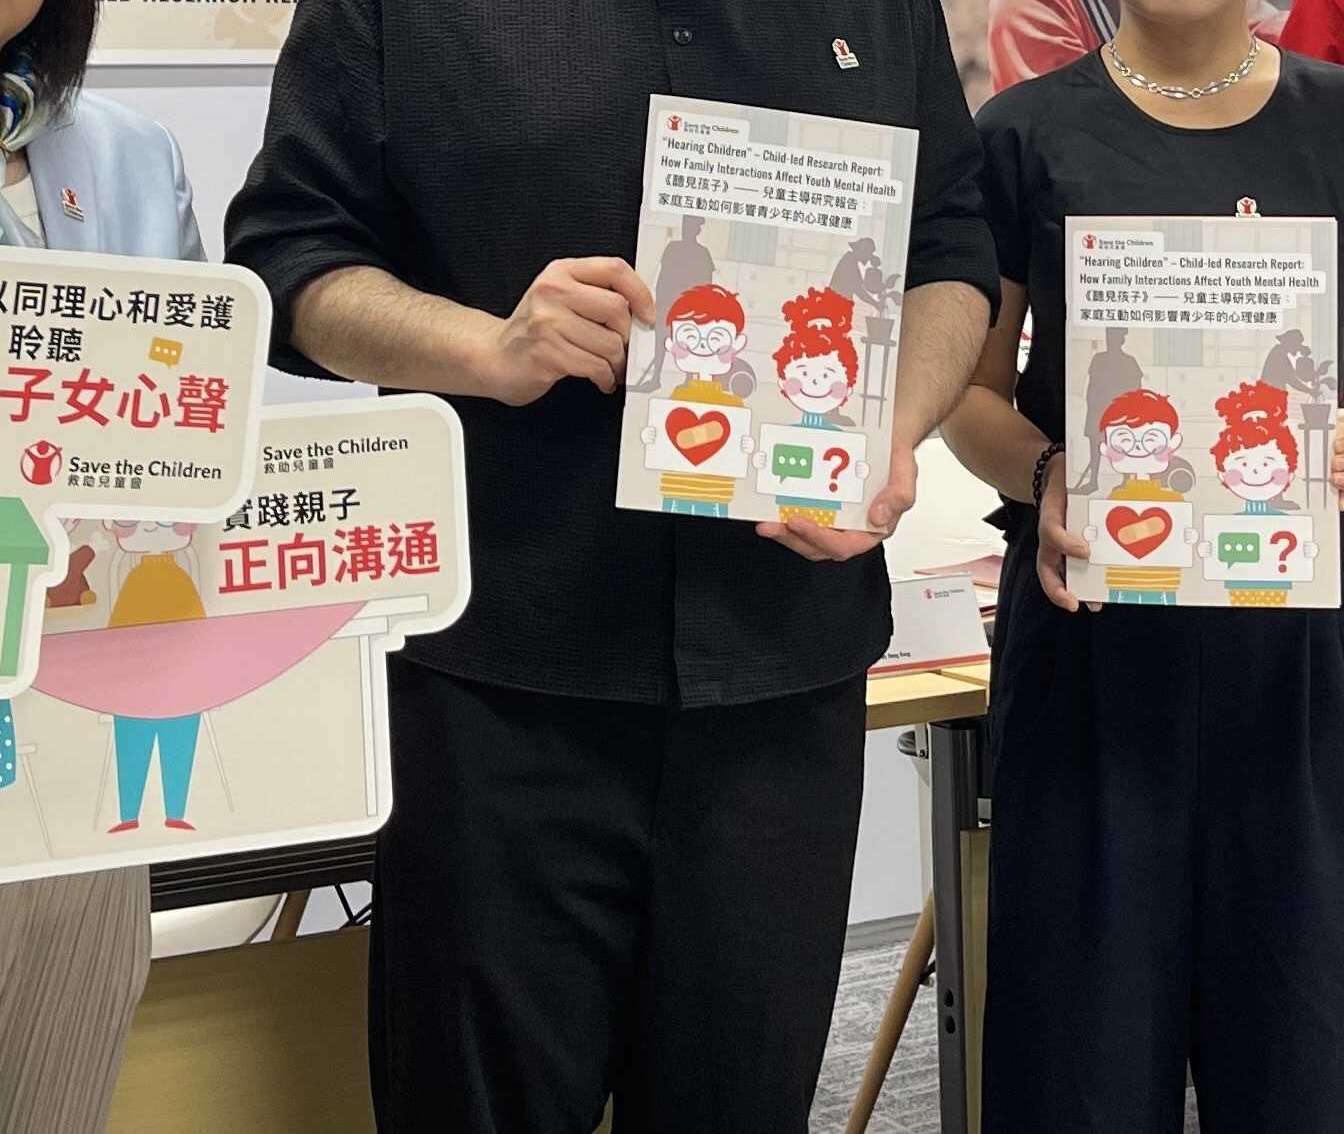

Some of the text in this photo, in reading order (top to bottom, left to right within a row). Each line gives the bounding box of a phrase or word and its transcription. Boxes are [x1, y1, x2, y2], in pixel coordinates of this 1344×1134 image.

[762, 150, 804, 167] Child-led
[807, 155, 849, 172] Research
[661, 155, 897, 197] How Family Interactions Affect Youth Mental Health
[1179, 257, 1222, 269] Child-led
[1225, 258, 1268, 269] Research
[1270, 258, 1304, 271] Report:
[1080, 274, 1320, 288] How Family Interactions Affect Youth Mental Health
[8, 324, 84, 363] 聆聽
[0, 366, 230, 434] 子女心聲
[263, 436, 409, 461] Save the Children
[69, 456, 223, 480] Save the Children
[219, 521, 441, 594] 正向溝通
